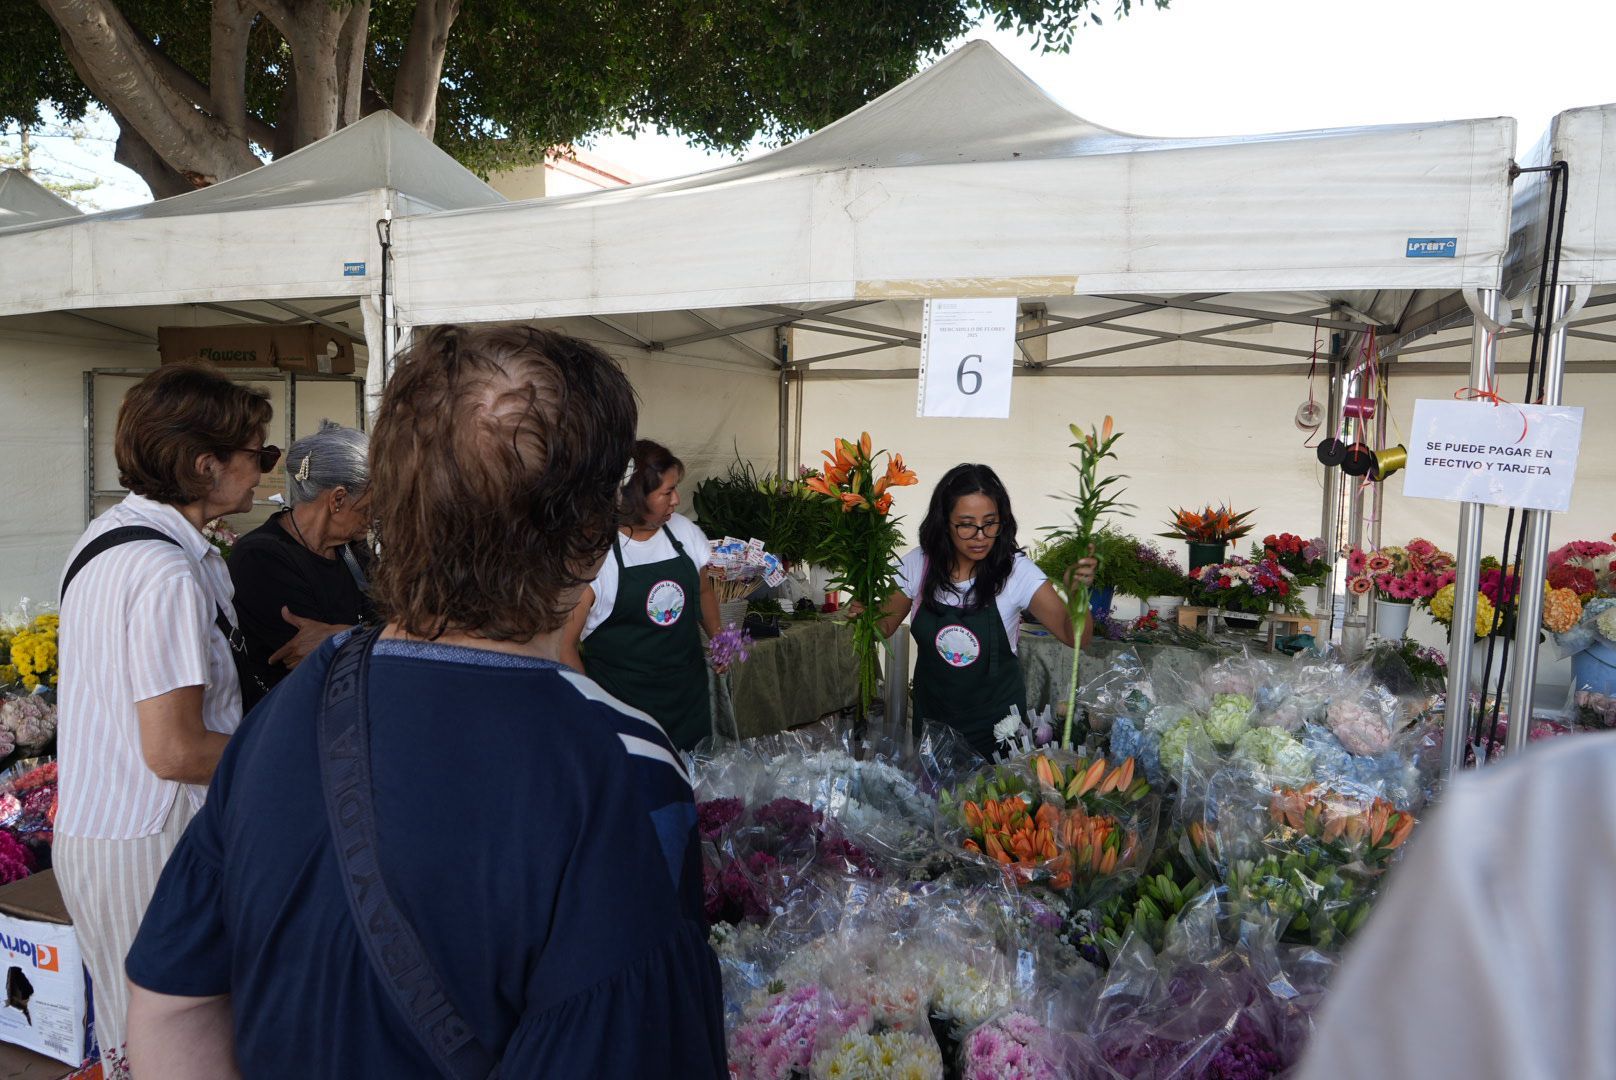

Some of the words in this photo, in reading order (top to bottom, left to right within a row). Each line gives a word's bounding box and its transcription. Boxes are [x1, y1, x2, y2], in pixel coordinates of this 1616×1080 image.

[199, 348, 257, 362] Flowers
[956, 354, 983, 396] 6
[1426, 441, 1442, 451] SE
[1445, 443, 1486, 454] PUEDE
[1488, 446, 1532, 458] PAGAR
[1535, 449, 1553, 459] EN
[1424, 457, 1483, 470] EFECTIVO
[1486, 462, 1495, 471] Y
[1497, 463, 1552, 476] TARJETA
[368, 902, 477, 1057] BIMBA
